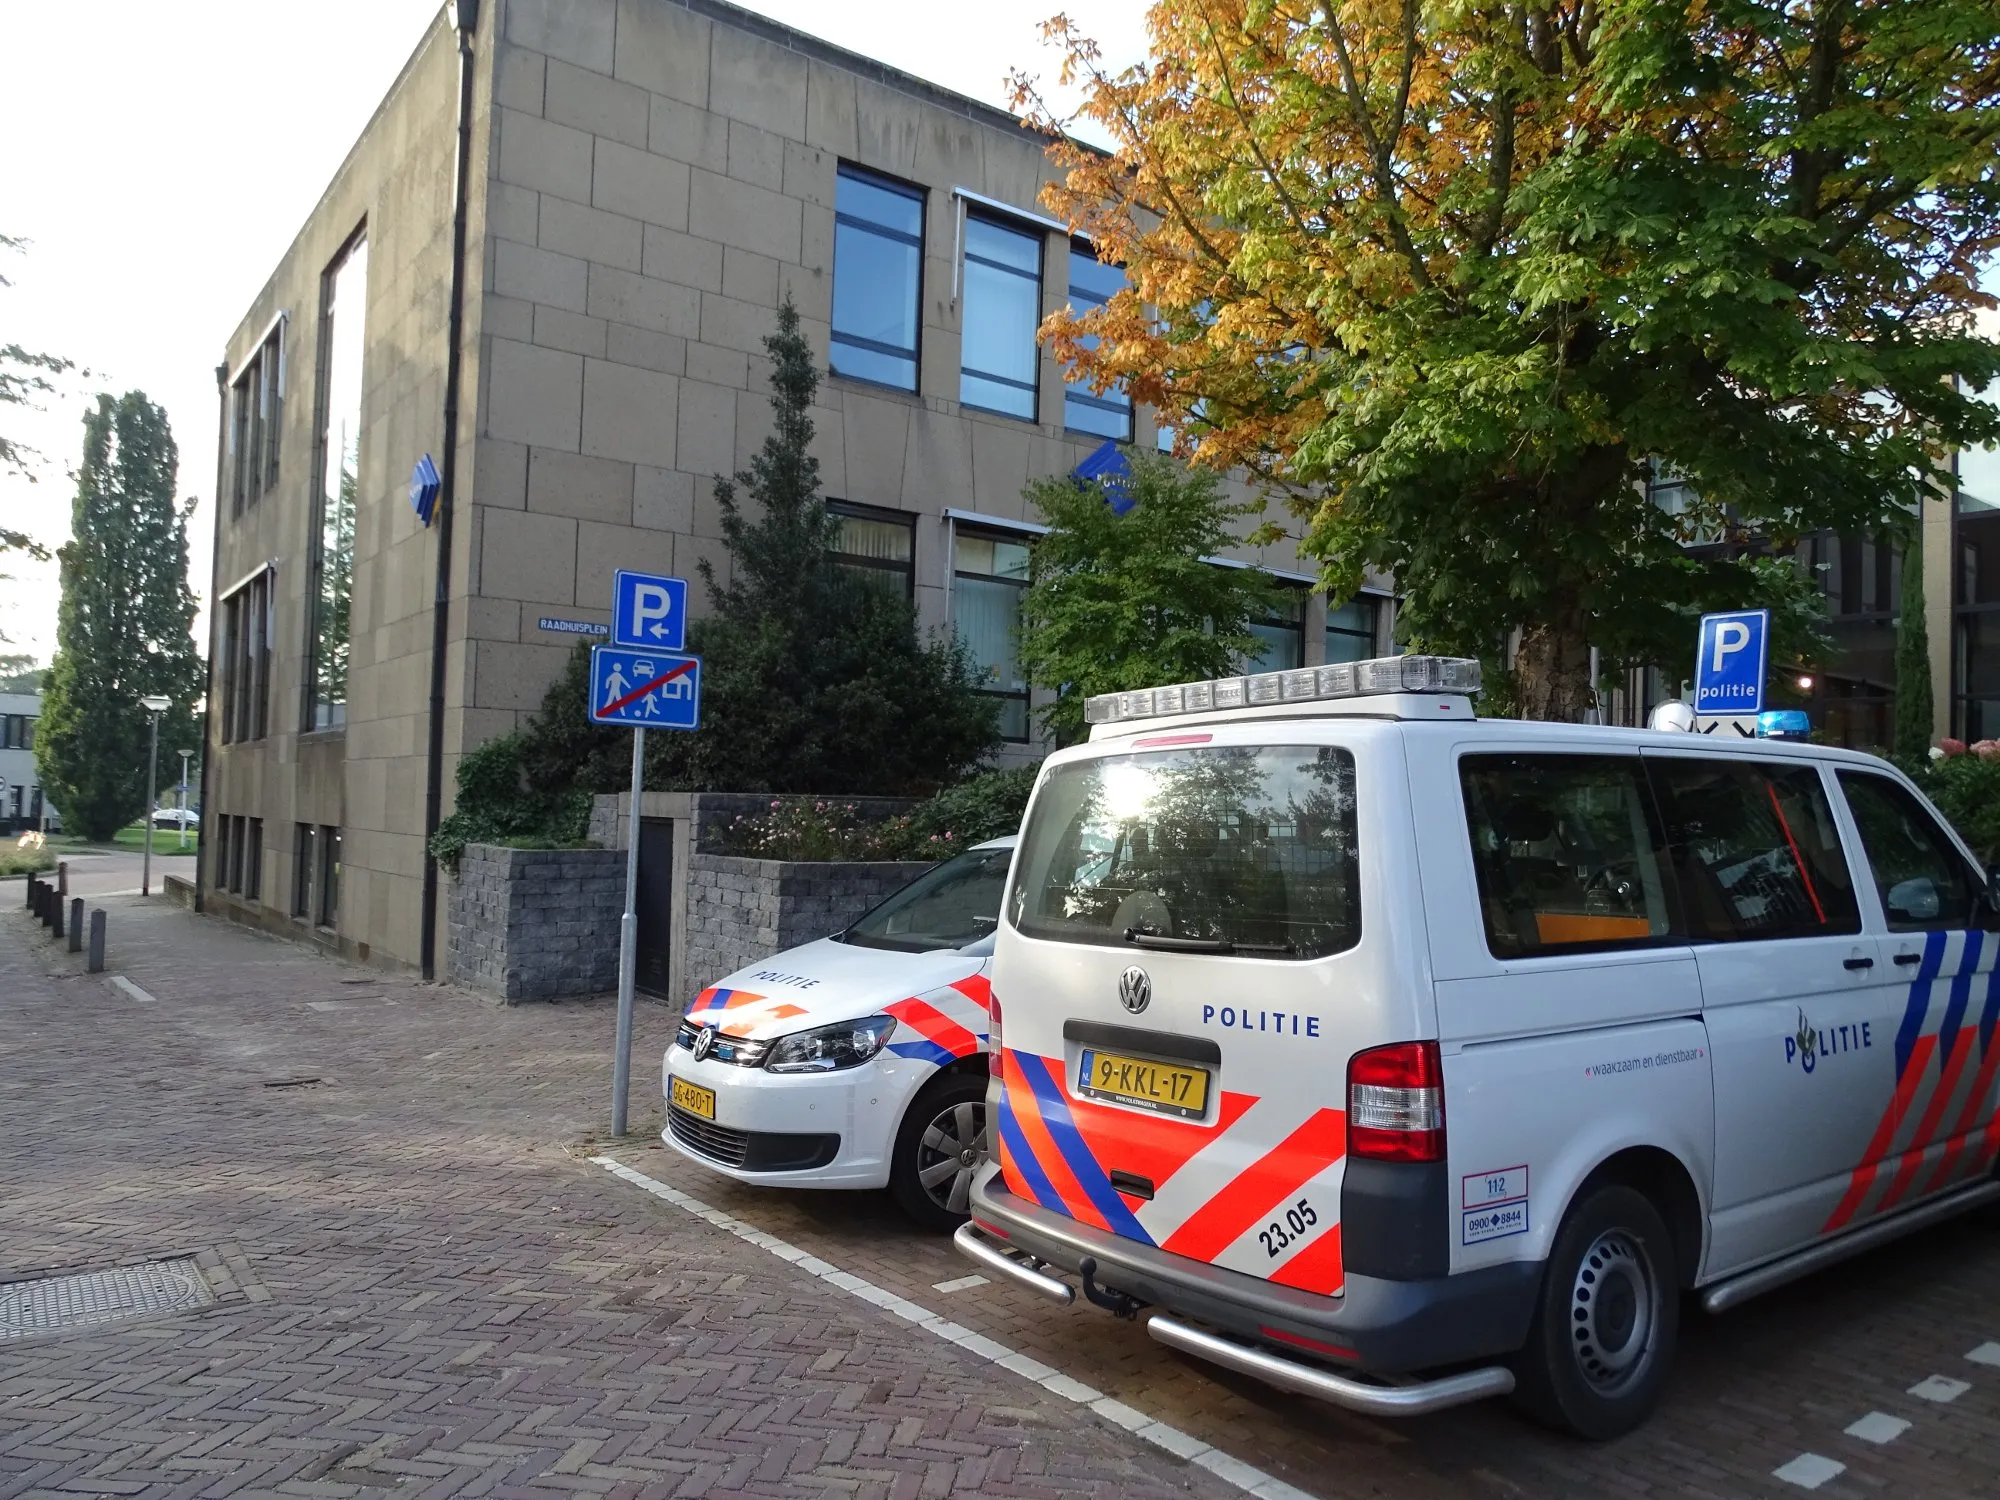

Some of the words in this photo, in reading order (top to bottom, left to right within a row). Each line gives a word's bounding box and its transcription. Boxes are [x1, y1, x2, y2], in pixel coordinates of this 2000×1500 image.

[632, 583, 671, 637] P
[540, 619, 608, 635] RAADHUISPLEIN
[1712, 621, 1750, 672] P
[1700, 684, 1756, 700] politie
[749, 971, 821, 989] POLITIE
[1203, 1004, 1320, 1038] POLITIE
[1642, 1056, 1654, 1069] en
[1081, 1072, 1090, 1082] NL
[1101, 1059, 1193, 1102] 9-KKL-17
[1258, 1198, 1318, 1259] 23.05
[1469, 1216, 1490, 1231] 0900
[1500, 1209, 1521, 1224] 8844
